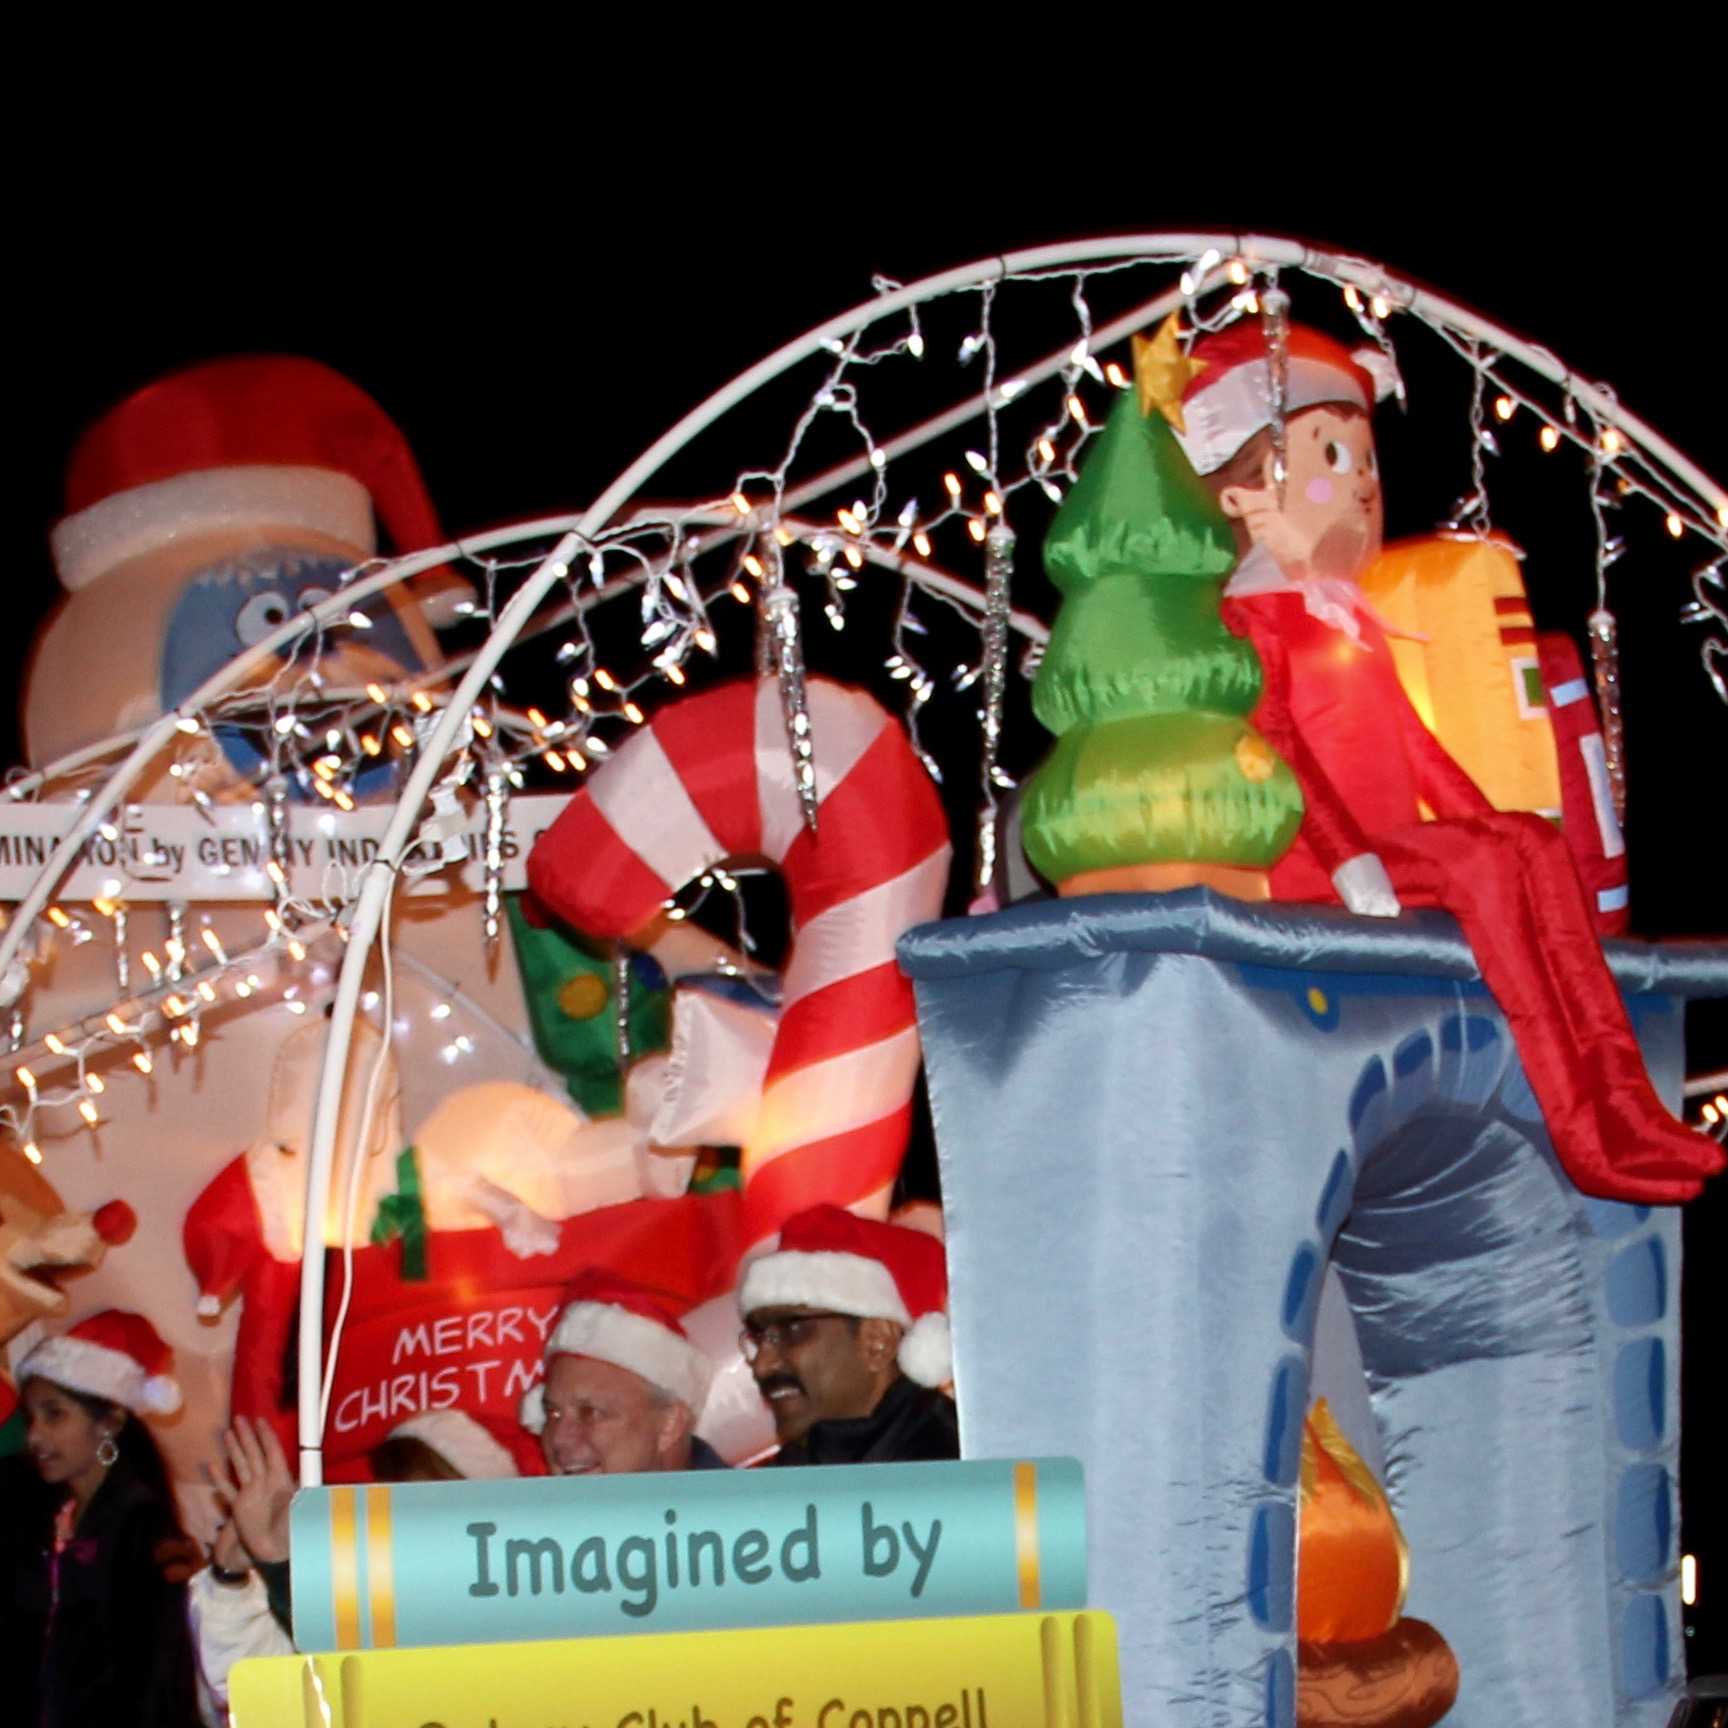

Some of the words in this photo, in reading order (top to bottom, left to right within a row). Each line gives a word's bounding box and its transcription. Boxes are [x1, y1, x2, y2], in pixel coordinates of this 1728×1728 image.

[152, 837, 185, 873] by
[392, 1306, 559, 1365] MERRY
[335, 1359, 545, 1433] CHRISTM
[467, 1505, 821, 1616] Imagined
[862, 1503, 942, 1597] by
